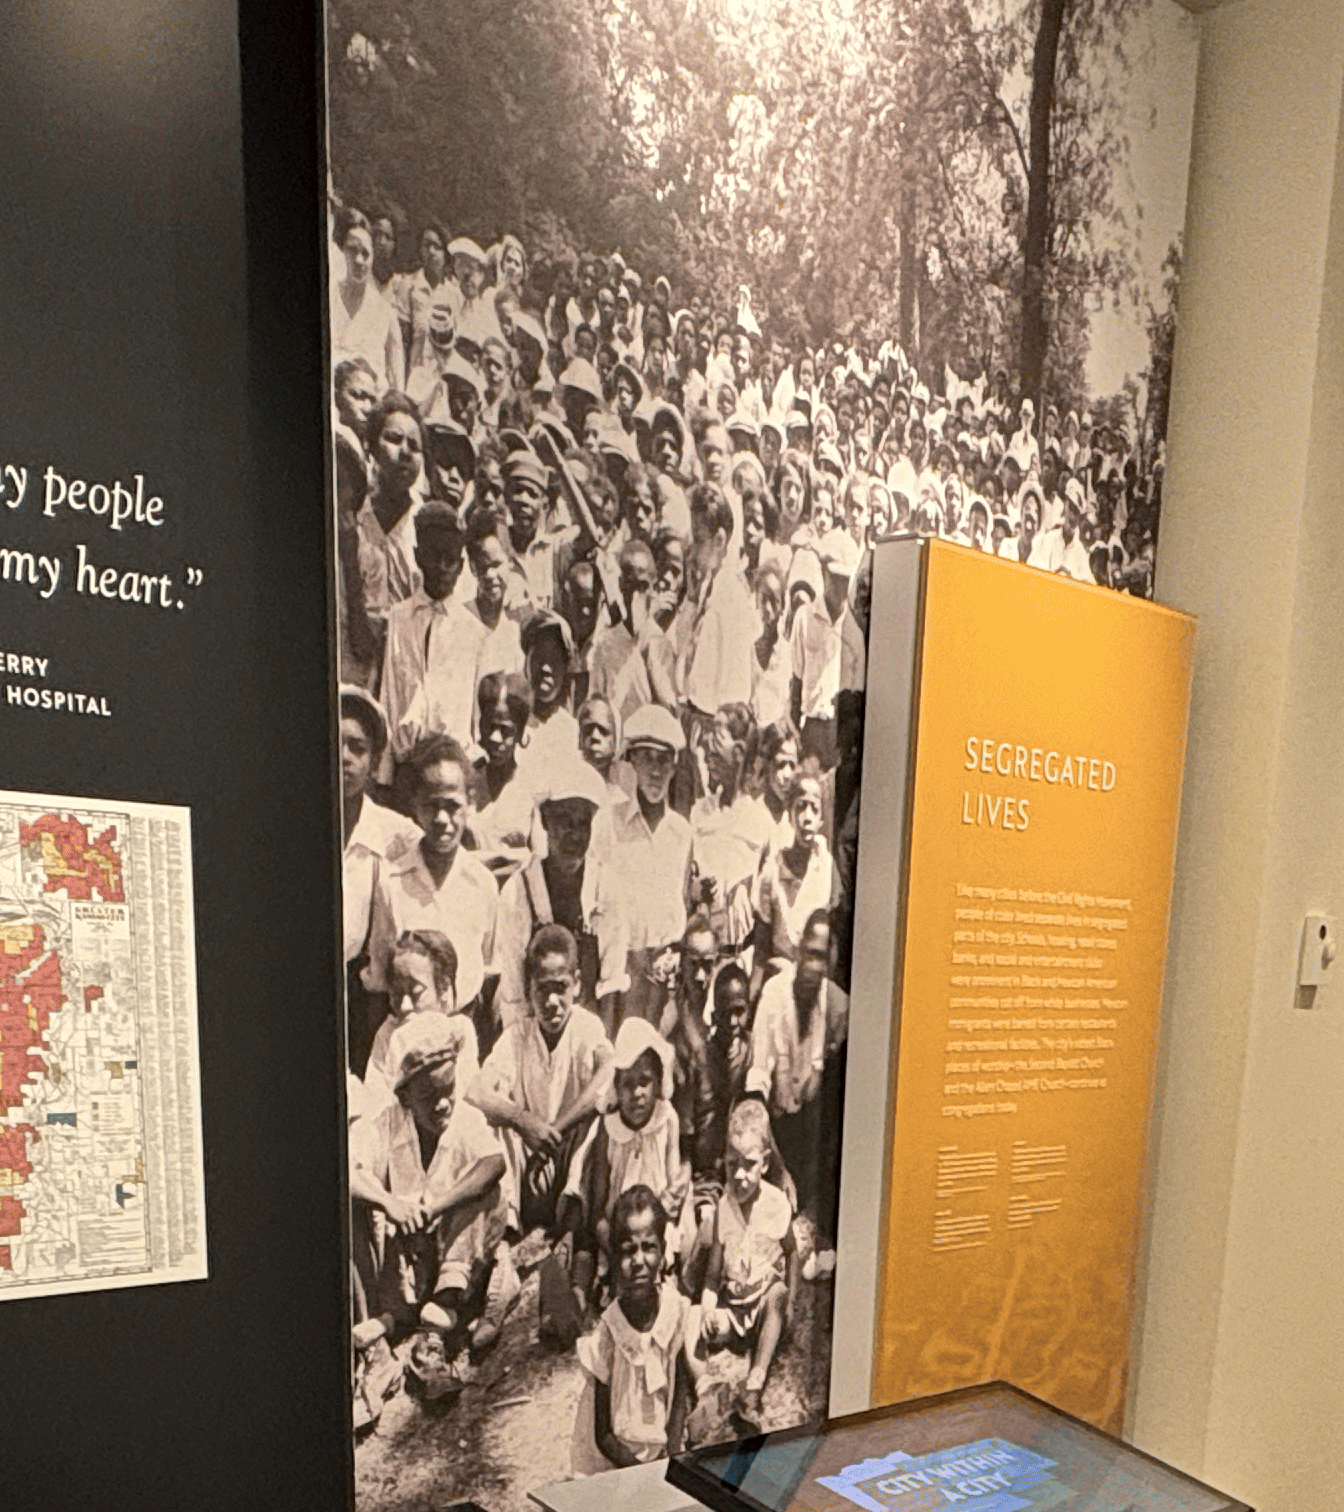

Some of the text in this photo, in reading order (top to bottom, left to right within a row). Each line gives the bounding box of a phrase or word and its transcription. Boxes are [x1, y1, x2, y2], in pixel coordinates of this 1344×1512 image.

[43, 465, 164, 530] people
[0, 549, 61, 598] my
[77, 546, 203, 610] heart.”
[7, 685, 112, 717] HOSPITAL
[965, 736, 1116, 791] SEGREGATED
[963, 792, 1030, 830] LIVES
[876, 1450, 1016, 1495] CITY WITHIN
[940, 1472, 1013, 1503] A CITY
